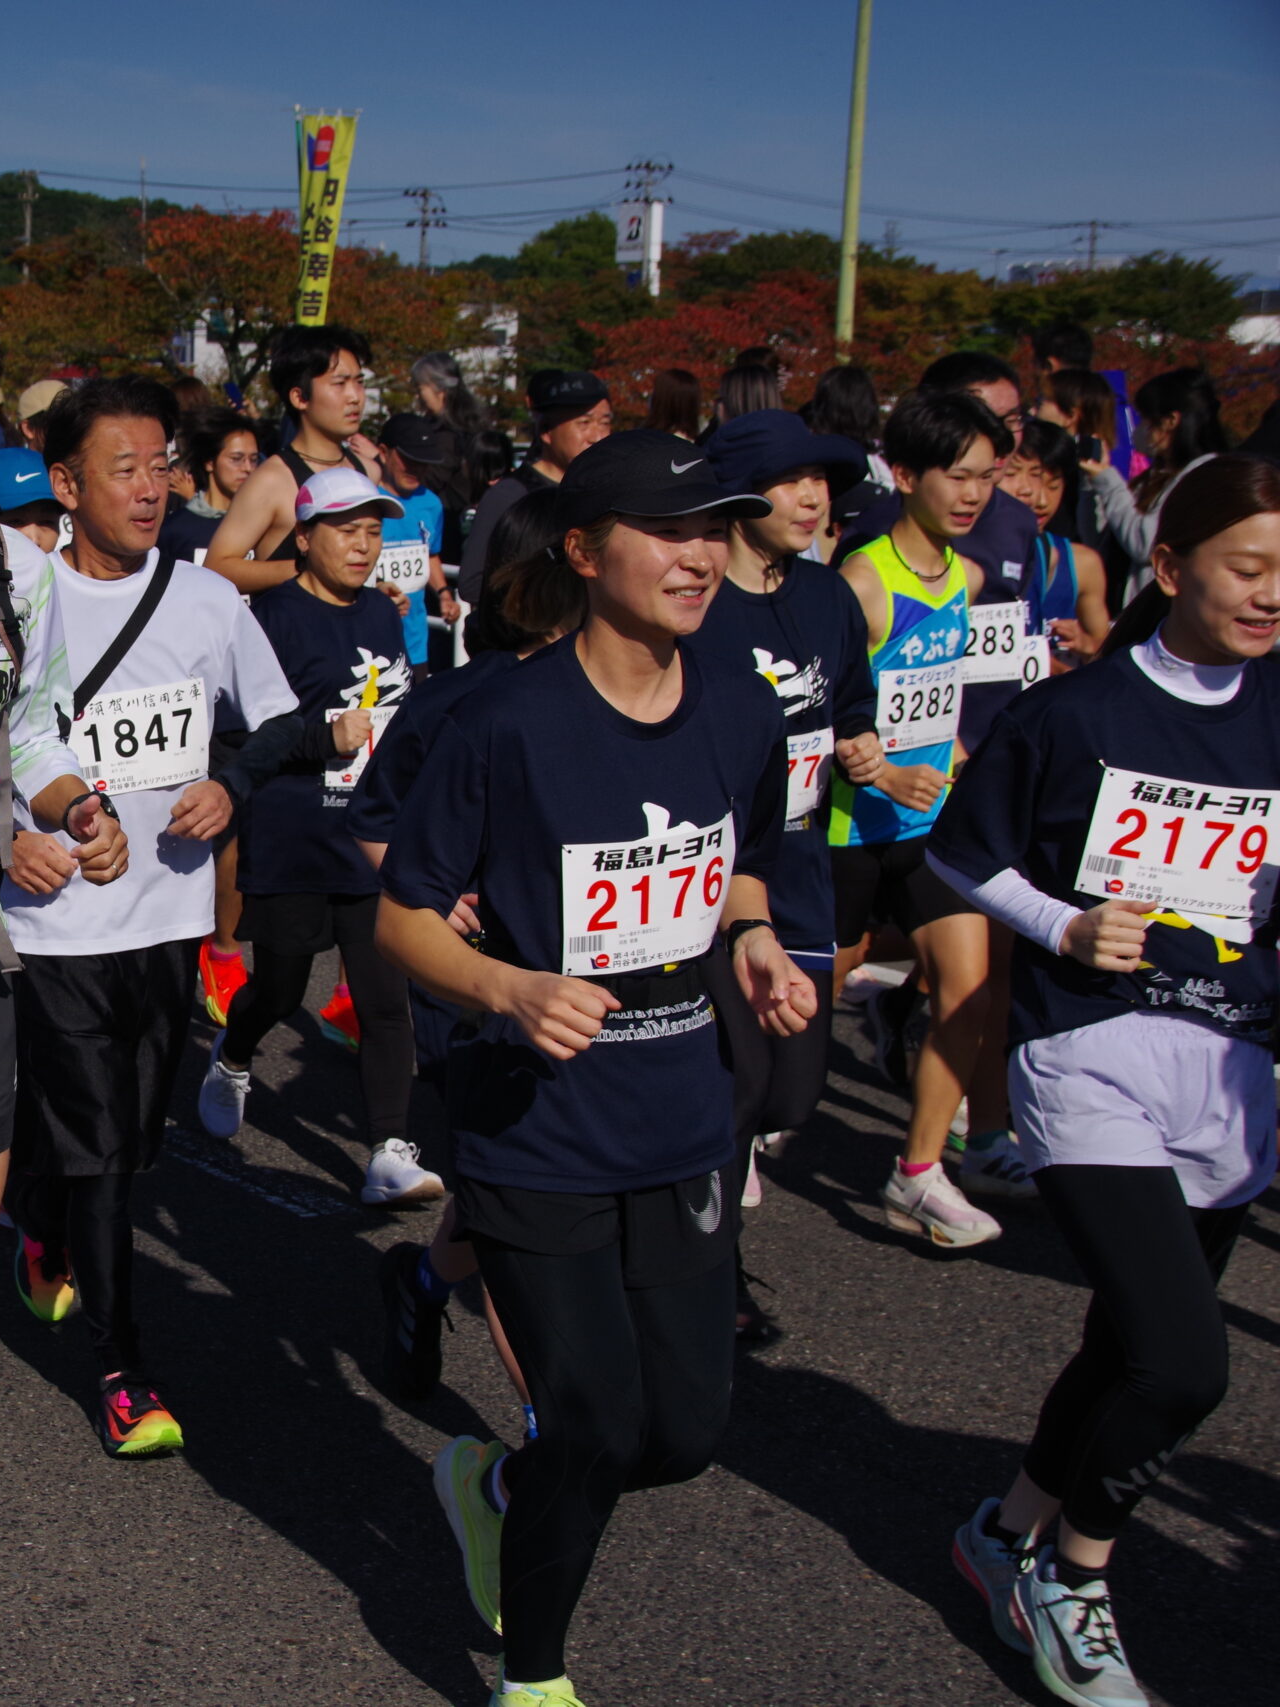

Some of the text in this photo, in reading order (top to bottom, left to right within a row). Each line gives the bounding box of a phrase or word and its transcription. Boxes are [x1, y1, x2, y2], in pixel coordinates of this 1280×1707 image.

[379, 558, 423, 580] 1832
[963, 624, 1014, 657] 283
[89, 683, 203, 716] 須賀川信用金庫
[888, 684, 954, 724] 3282
[84, 708, 192, 762] 1847
[787, 754, 821, 788] 77
[1129, 780, 1273, 817] 福島トヨタ
[592, 827, 724, 872] 福島トヨタ
[1108, 808, 1268, 874] 2179
[587, 856, 724, 932] 2176
